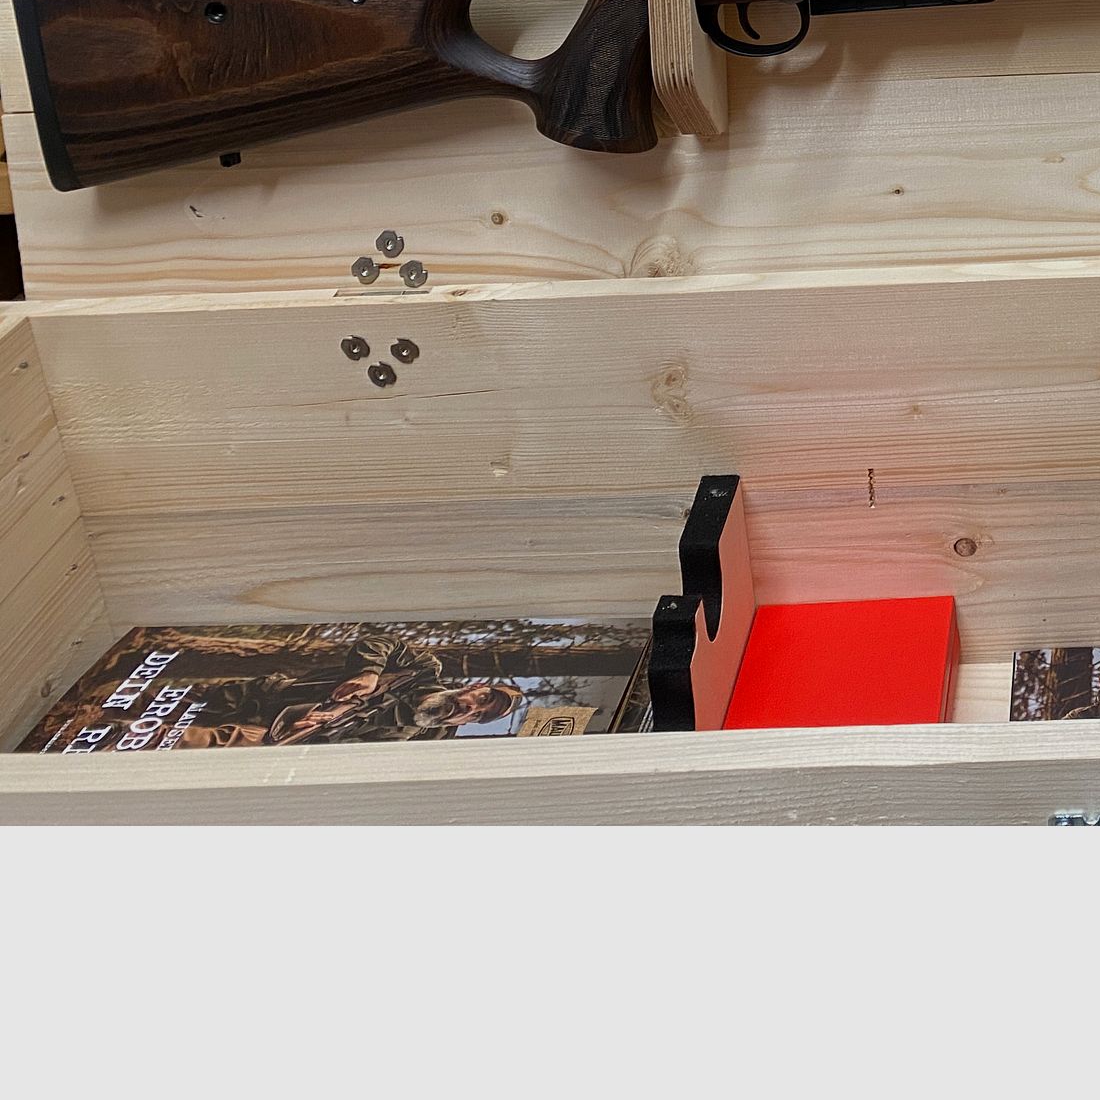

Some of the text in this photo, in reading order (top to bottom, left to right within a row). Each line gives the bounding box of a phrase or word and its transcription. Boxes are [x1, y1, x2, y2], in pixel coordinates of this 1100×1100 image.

[102, 651, 180, 711] DEIN
[113, 685, 193, 752] EROB
[155, 701, 208, 751] MAUSE
